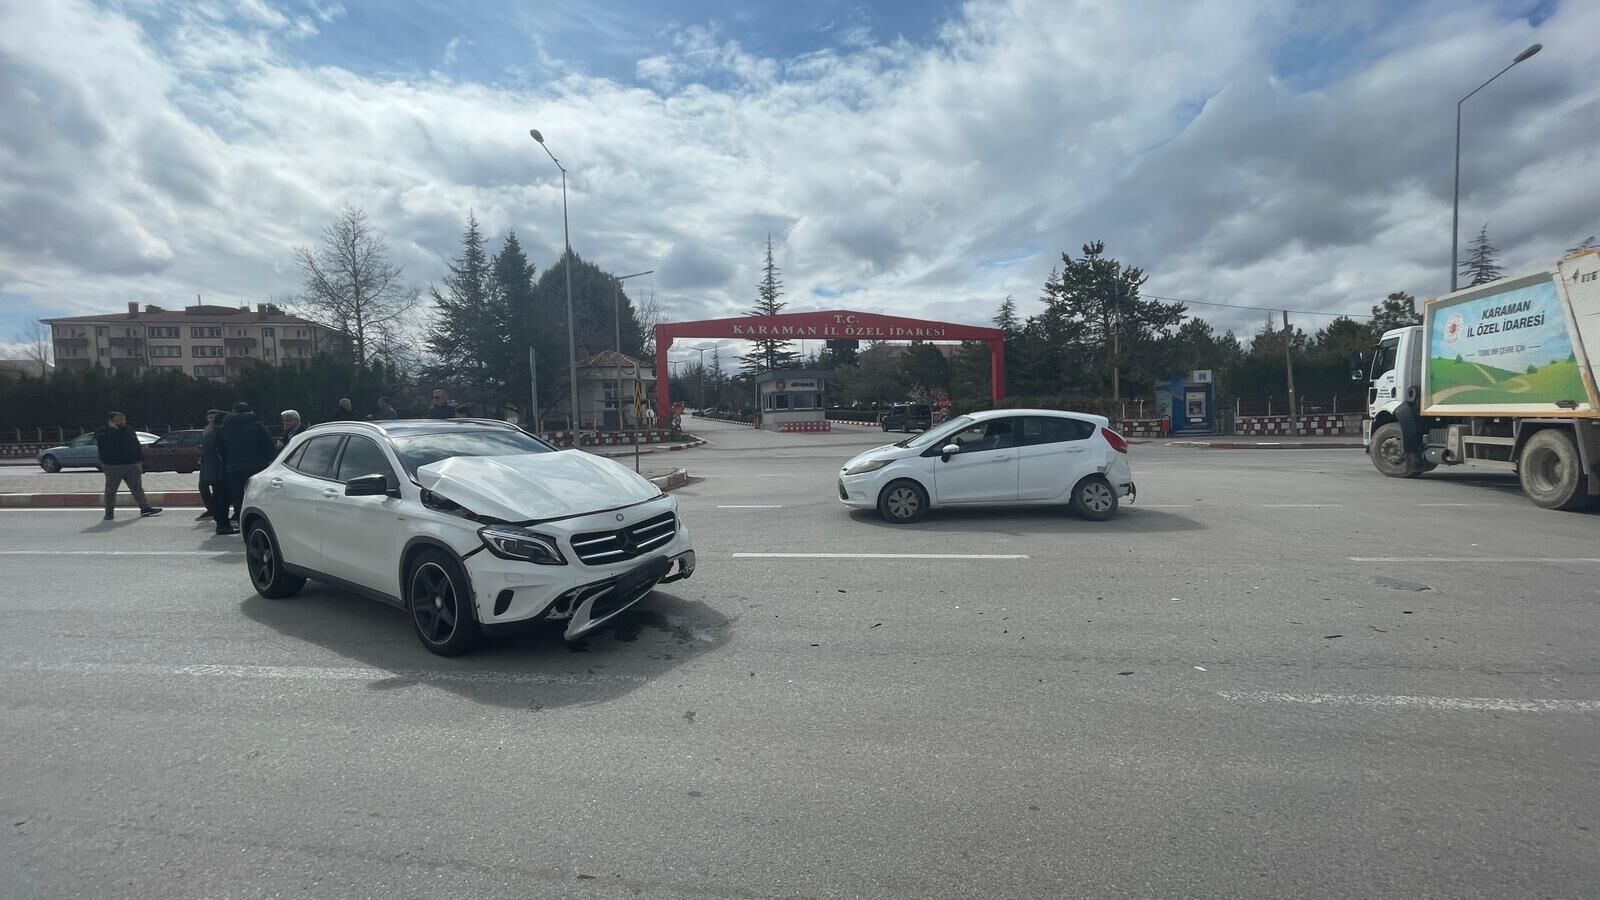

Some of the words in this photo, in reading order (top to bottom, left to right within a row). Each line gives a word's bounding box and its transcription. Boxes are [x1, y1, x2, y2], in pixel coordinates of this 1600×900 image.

[1481, 300, 1532, 320] KARAMAN
[834, 314, 860, 324] T.C.
[1467, 325, 1475, 338] İL
[1476, 322, 1500, 336] ÖZEL
[1502, 310, 1546, 332] İDARESİ
[733, 325, 817, 335] KARAMAN
[824, 323, 839, 335] İL
[848, 322, 884, 336] ÖZEL
[889, 324, 946, 336] İDARESİ
